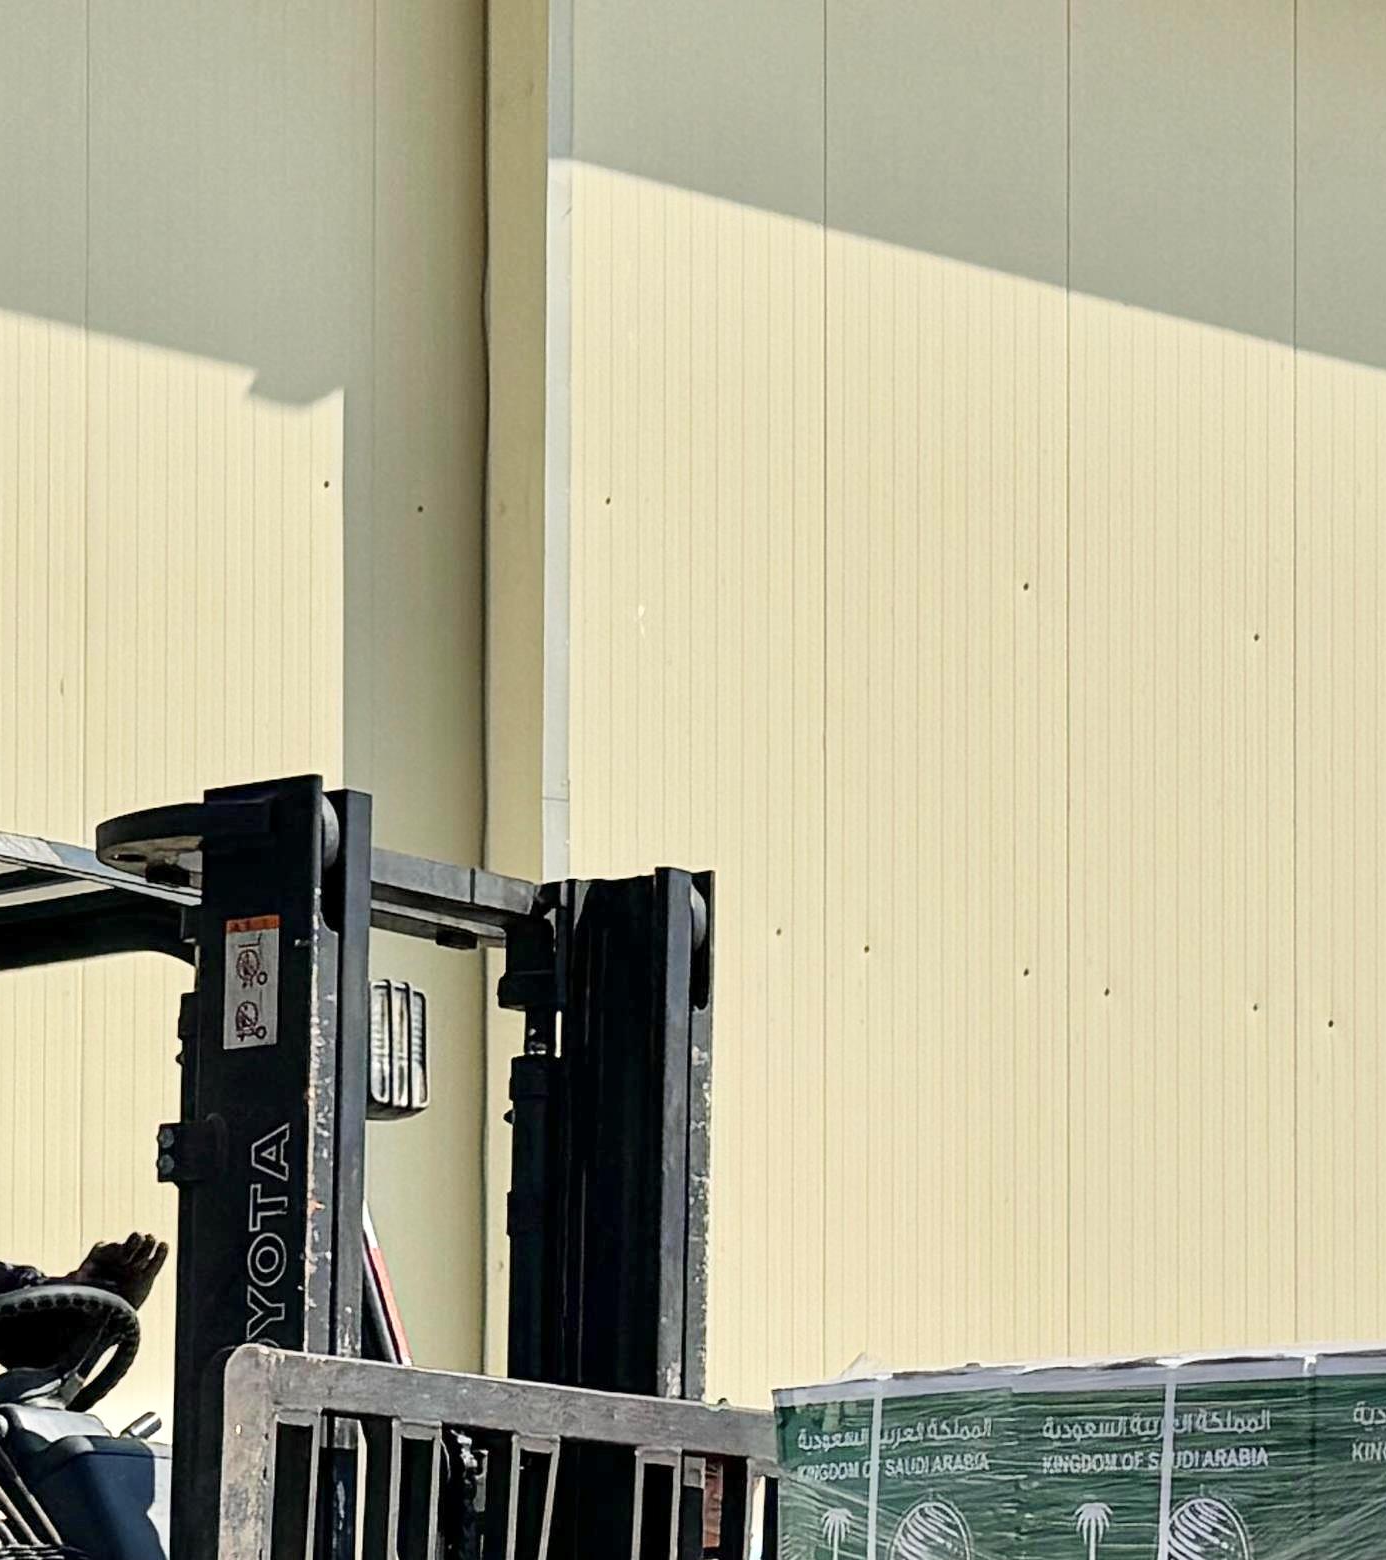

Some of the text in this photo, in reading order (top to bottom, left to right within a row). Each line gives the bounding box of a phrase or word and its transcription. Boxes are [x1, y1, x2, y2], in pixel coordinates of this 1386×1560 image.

[246, 1122, 290, 1348] YOTA
[797, 1451, 991, 1482] KINGDOM SAUDI ARABIA
[1042, 1447, 1270, 1475] KINGDOM OF SUDI ARABIA
